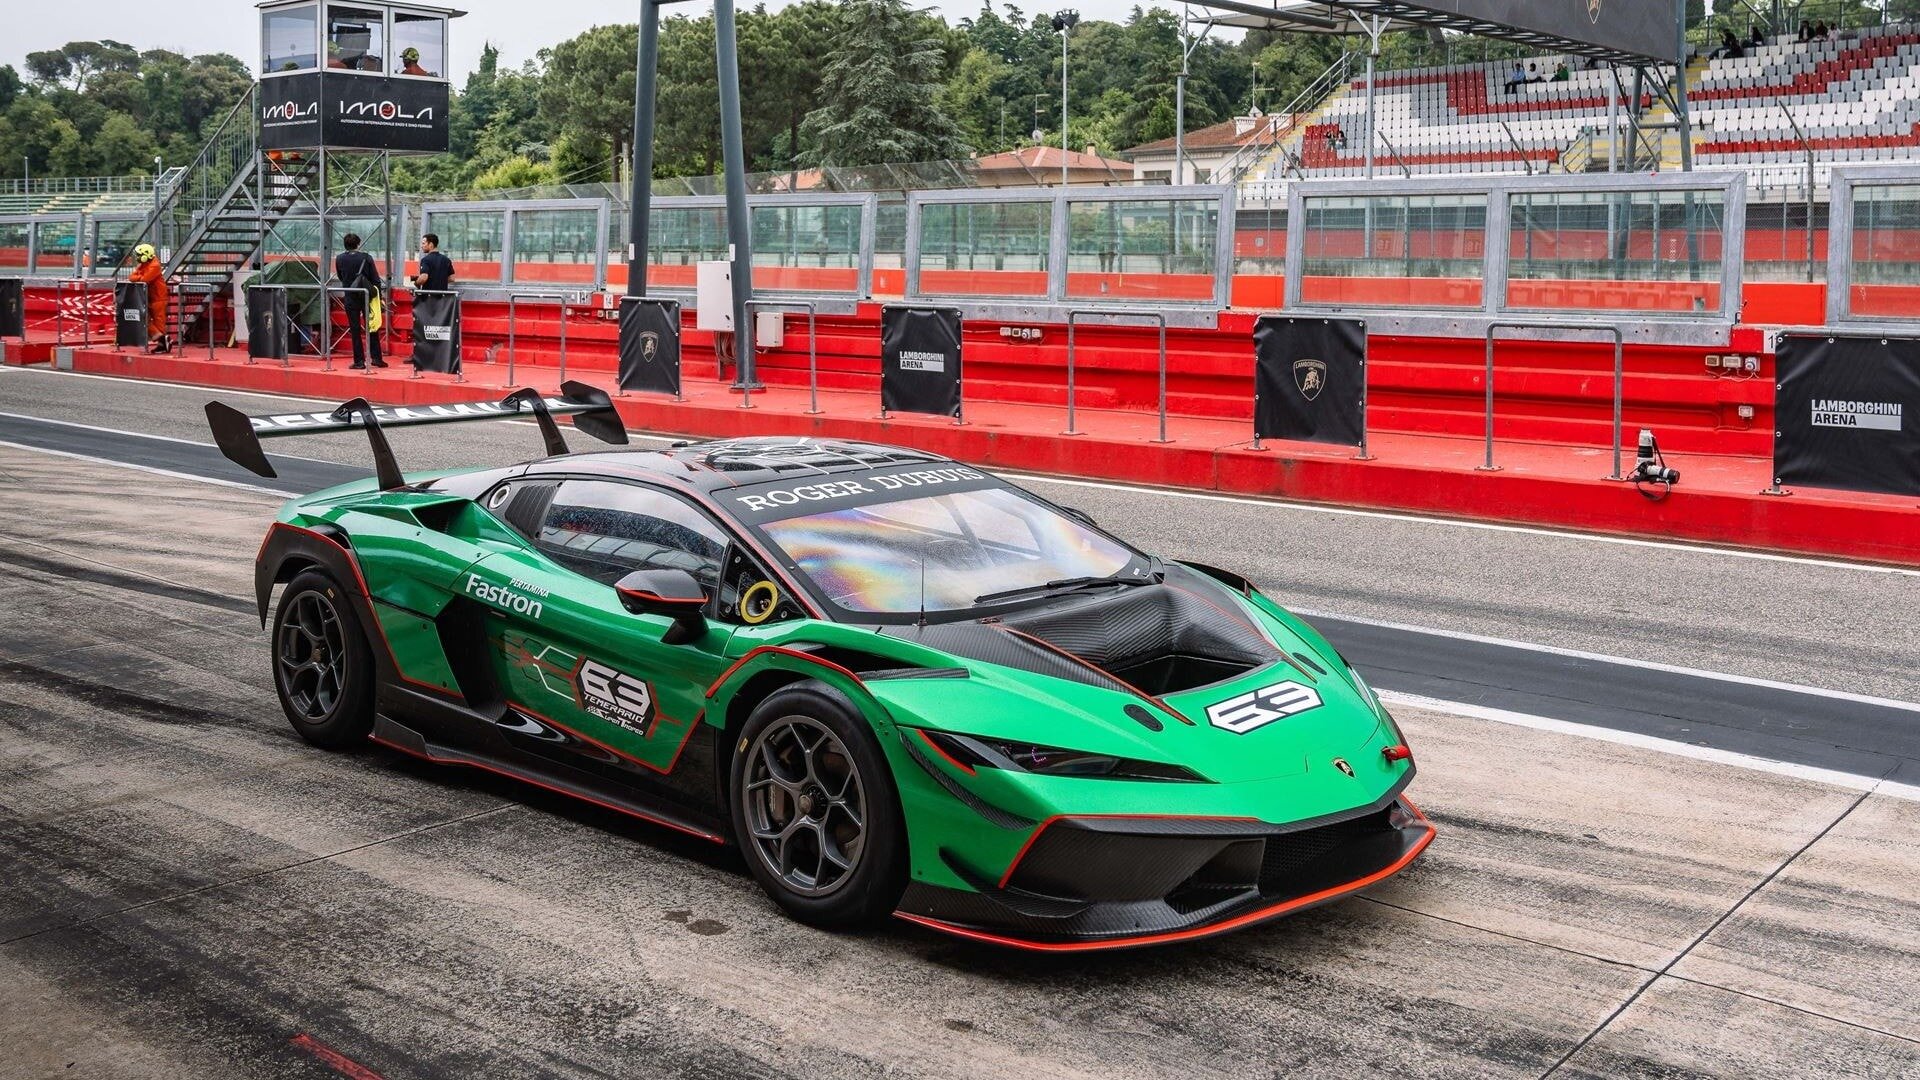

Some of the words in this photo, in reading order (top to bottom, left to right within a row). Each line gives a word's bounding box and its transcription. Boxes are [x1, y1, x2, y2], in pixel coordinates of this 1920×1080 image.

[263, 101, 318, 120] IMOLA
[340, 100, 433, 120] IMOLA
[899, 351, 944, 362] LAMBORGHINI
[901, 361, 924, 369] ARENA
[1811, 399, 1902, 416] LAMBORGHINI
[1814, 413, 1857, 426] ARENA
[736, 480, 875, 511] ROGER
[870, 467, 985, 490] DUBUIS
[466, 573, 543, 619] Fastron
[509, 577, 550, 598] PERTAMINA
[580, 659, 651, 717] 63
[584, 691, 646, 724] TEMERARIO
[1206, 679, 1323, 735] 63
